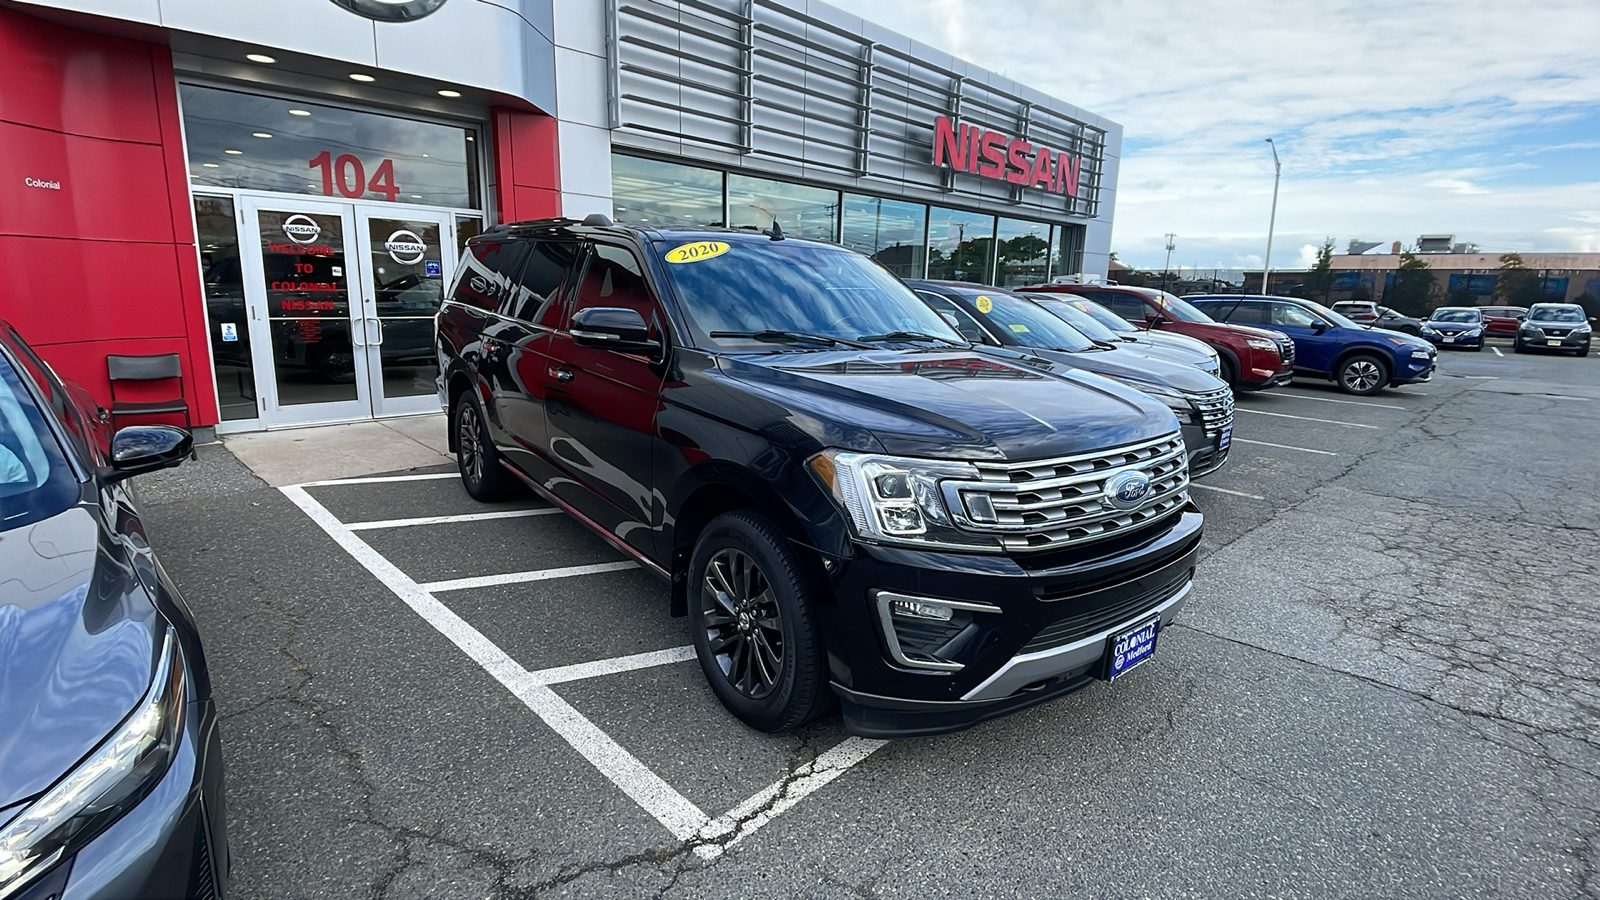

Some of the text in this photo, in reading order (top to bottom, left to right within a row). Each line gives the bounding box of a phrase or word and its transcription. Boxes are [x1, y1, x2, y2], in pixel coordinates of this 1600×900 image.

[933, 116, 1080, 197] NISSAN
[25, 177, 61, 190] Colonial
[308, 151, 400, 202] 104
[268, 243, 335, 256] WELCOME
[389, 243, 424, 252] NISSAN
[679, 242, 720, 261] 2020
[294, 263, 314, 273] TO
[271, 281, 338, 292] COLONIAL
[281, 301, 334, 310] NISSAN
[1125, 482, 1144, 499] Ford
[1115, 627, 1155, 656] COLONIAL
[1126, 640, 1152, 662] Medford
